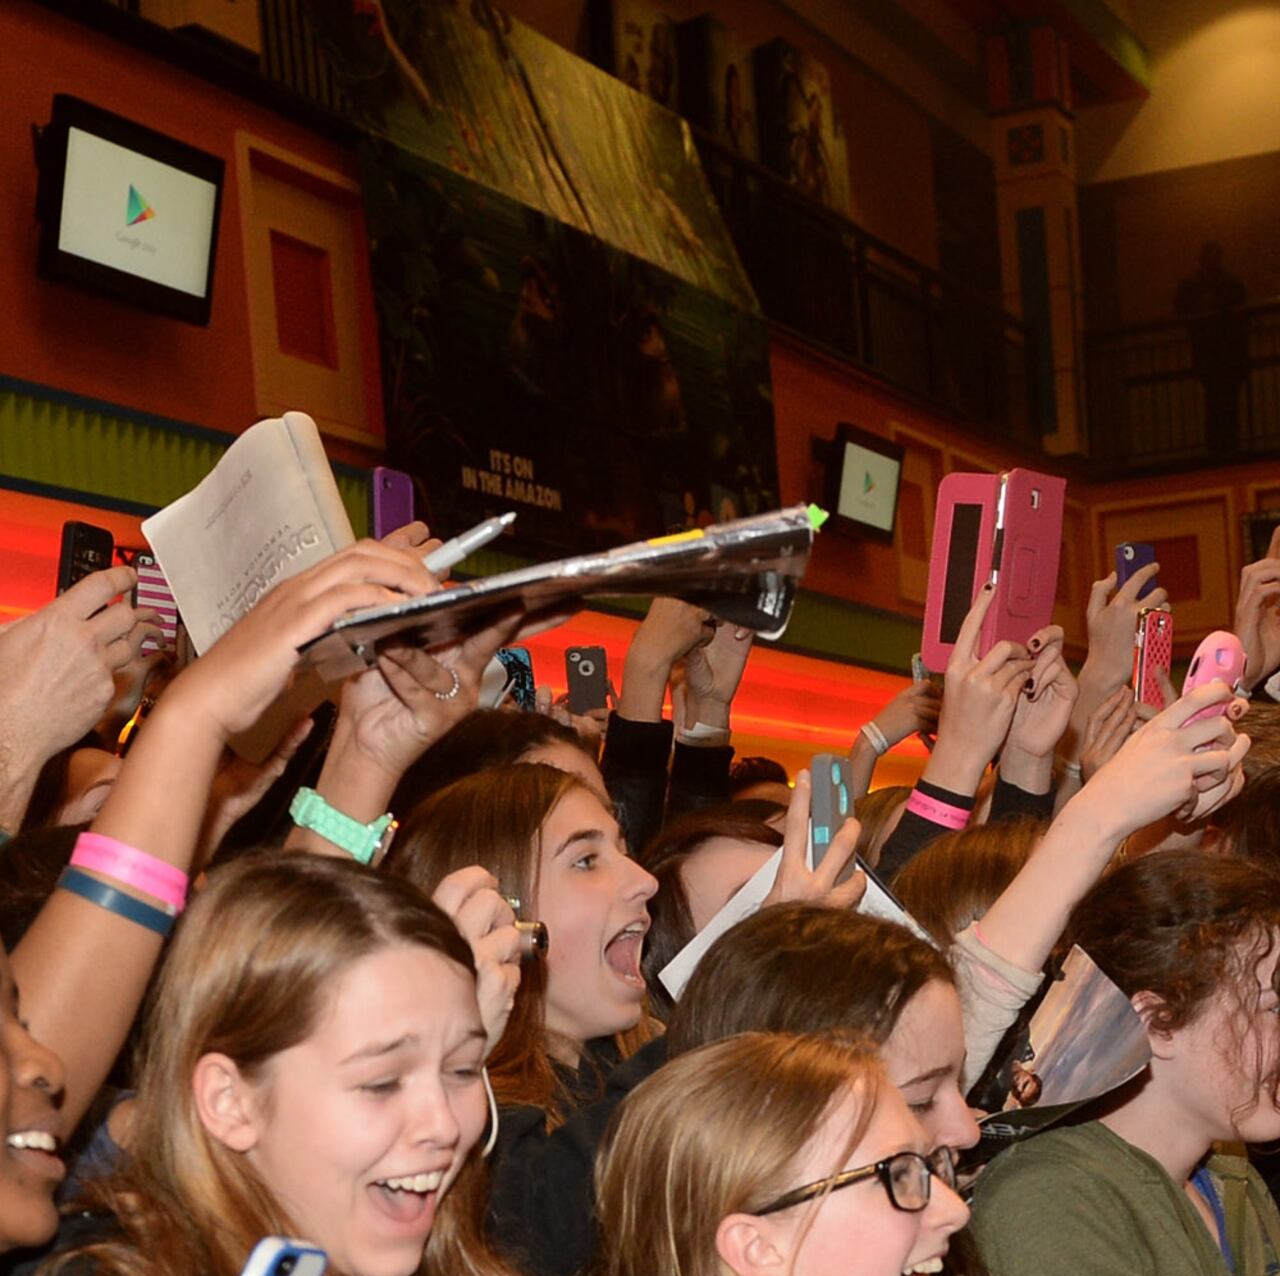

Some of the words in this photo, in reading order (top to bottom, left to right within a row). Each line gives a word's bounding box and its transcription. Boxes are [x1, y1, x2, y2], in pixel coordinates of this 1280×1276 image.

[513, 455, 534, 480] ON
[462, 465, 478, 491] IN
[479, 469, 503, 496] THE
[505, 478, 562, 511] AMAZON
